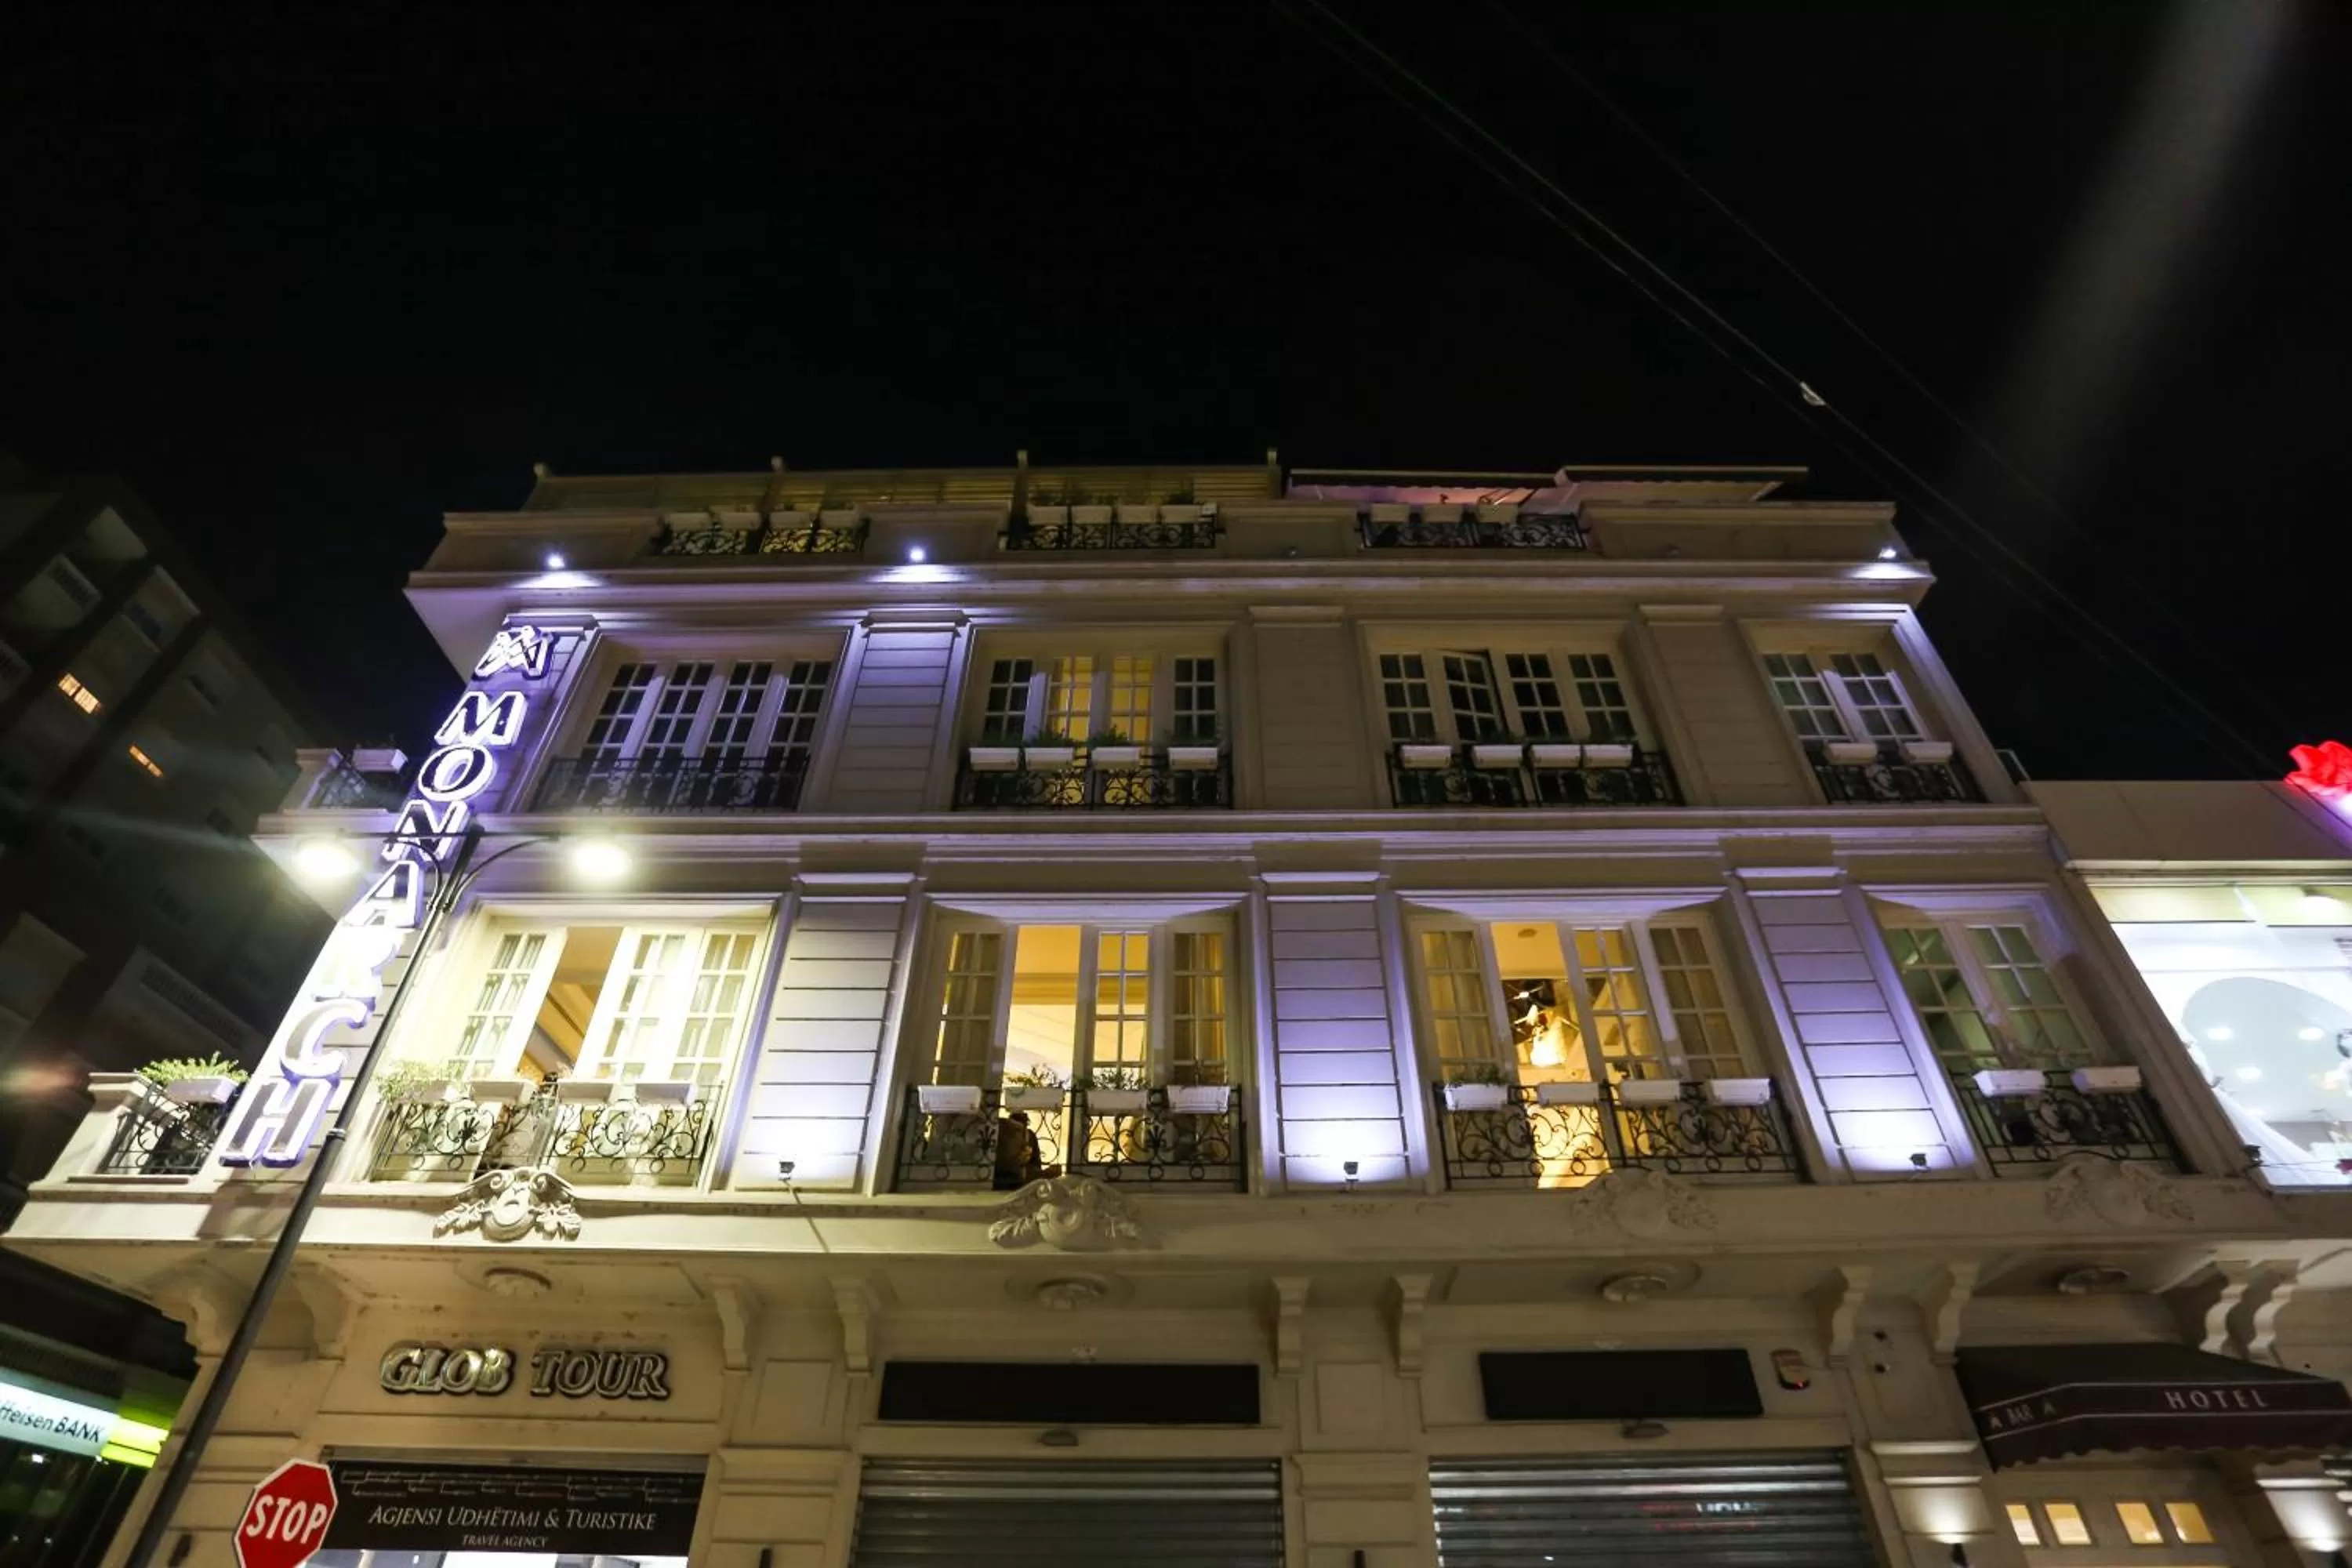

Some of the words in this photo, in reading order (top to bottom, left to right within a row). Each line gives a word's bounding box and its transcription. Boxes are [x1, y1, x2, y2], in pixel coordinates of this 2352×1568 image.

[380, 1341, 515, 1395] GLOB
[529, 1343, 670, 1399] TOUR
[2164, 1388, 2268, 1409] HOTEL
[54, 1417, 105, 1443] BANK
[246, 1494, 328, 1544] STOP
[368, 1504, 443, 1527] AGJENSI
[448, 1505, 541, 1528] UDHËTIMI
[544, 1510, 560, 1529] &
[565, 1508, 658, 1530] TURISTIKE
[461, 1534, 500, 1547] TRAVEL
[504, 1535, 549, 1549] AGENCY
